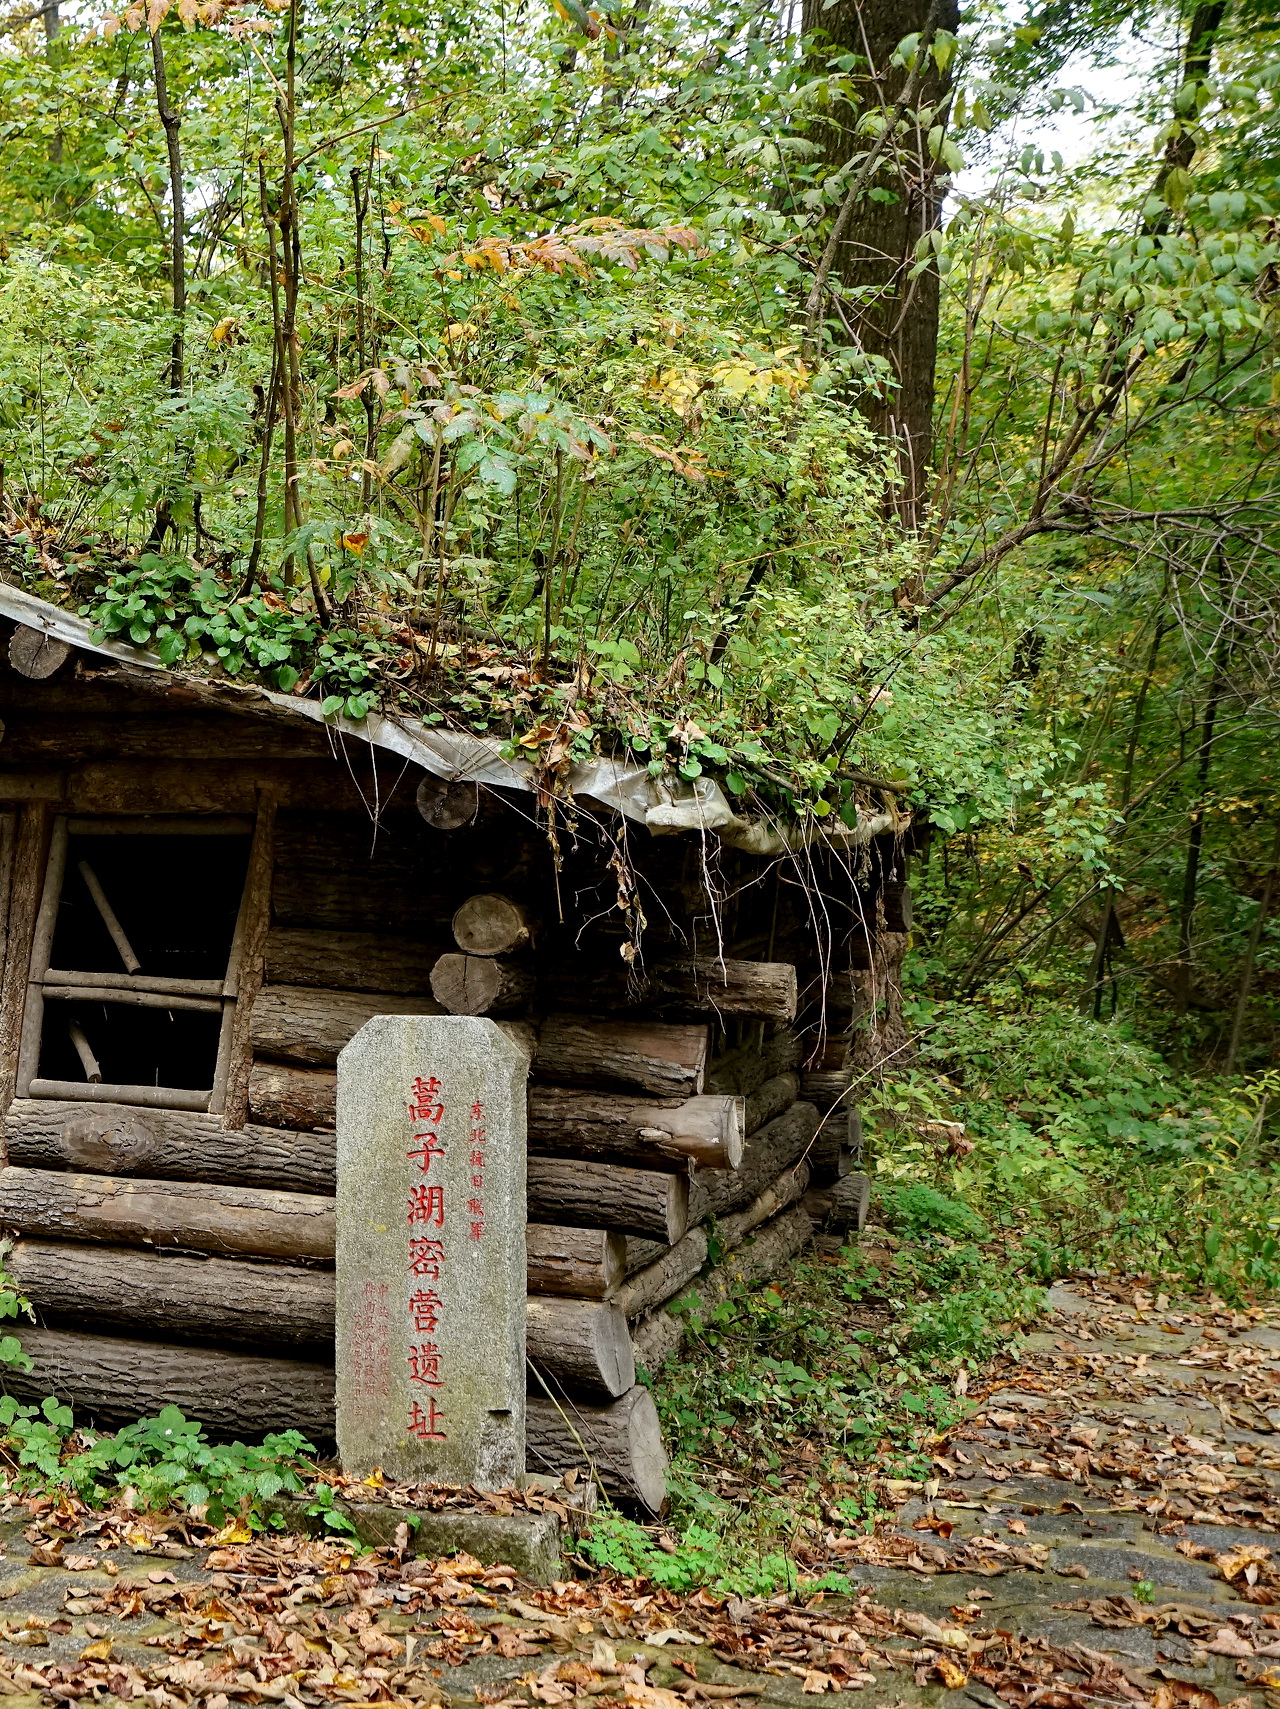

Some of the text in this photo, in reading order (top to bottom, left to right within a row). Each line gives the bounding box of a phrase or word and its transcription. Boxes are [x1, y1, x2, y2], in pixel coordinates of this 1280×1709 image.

[406, 1076, 447, 1442] 蒿子湖密营遗址
